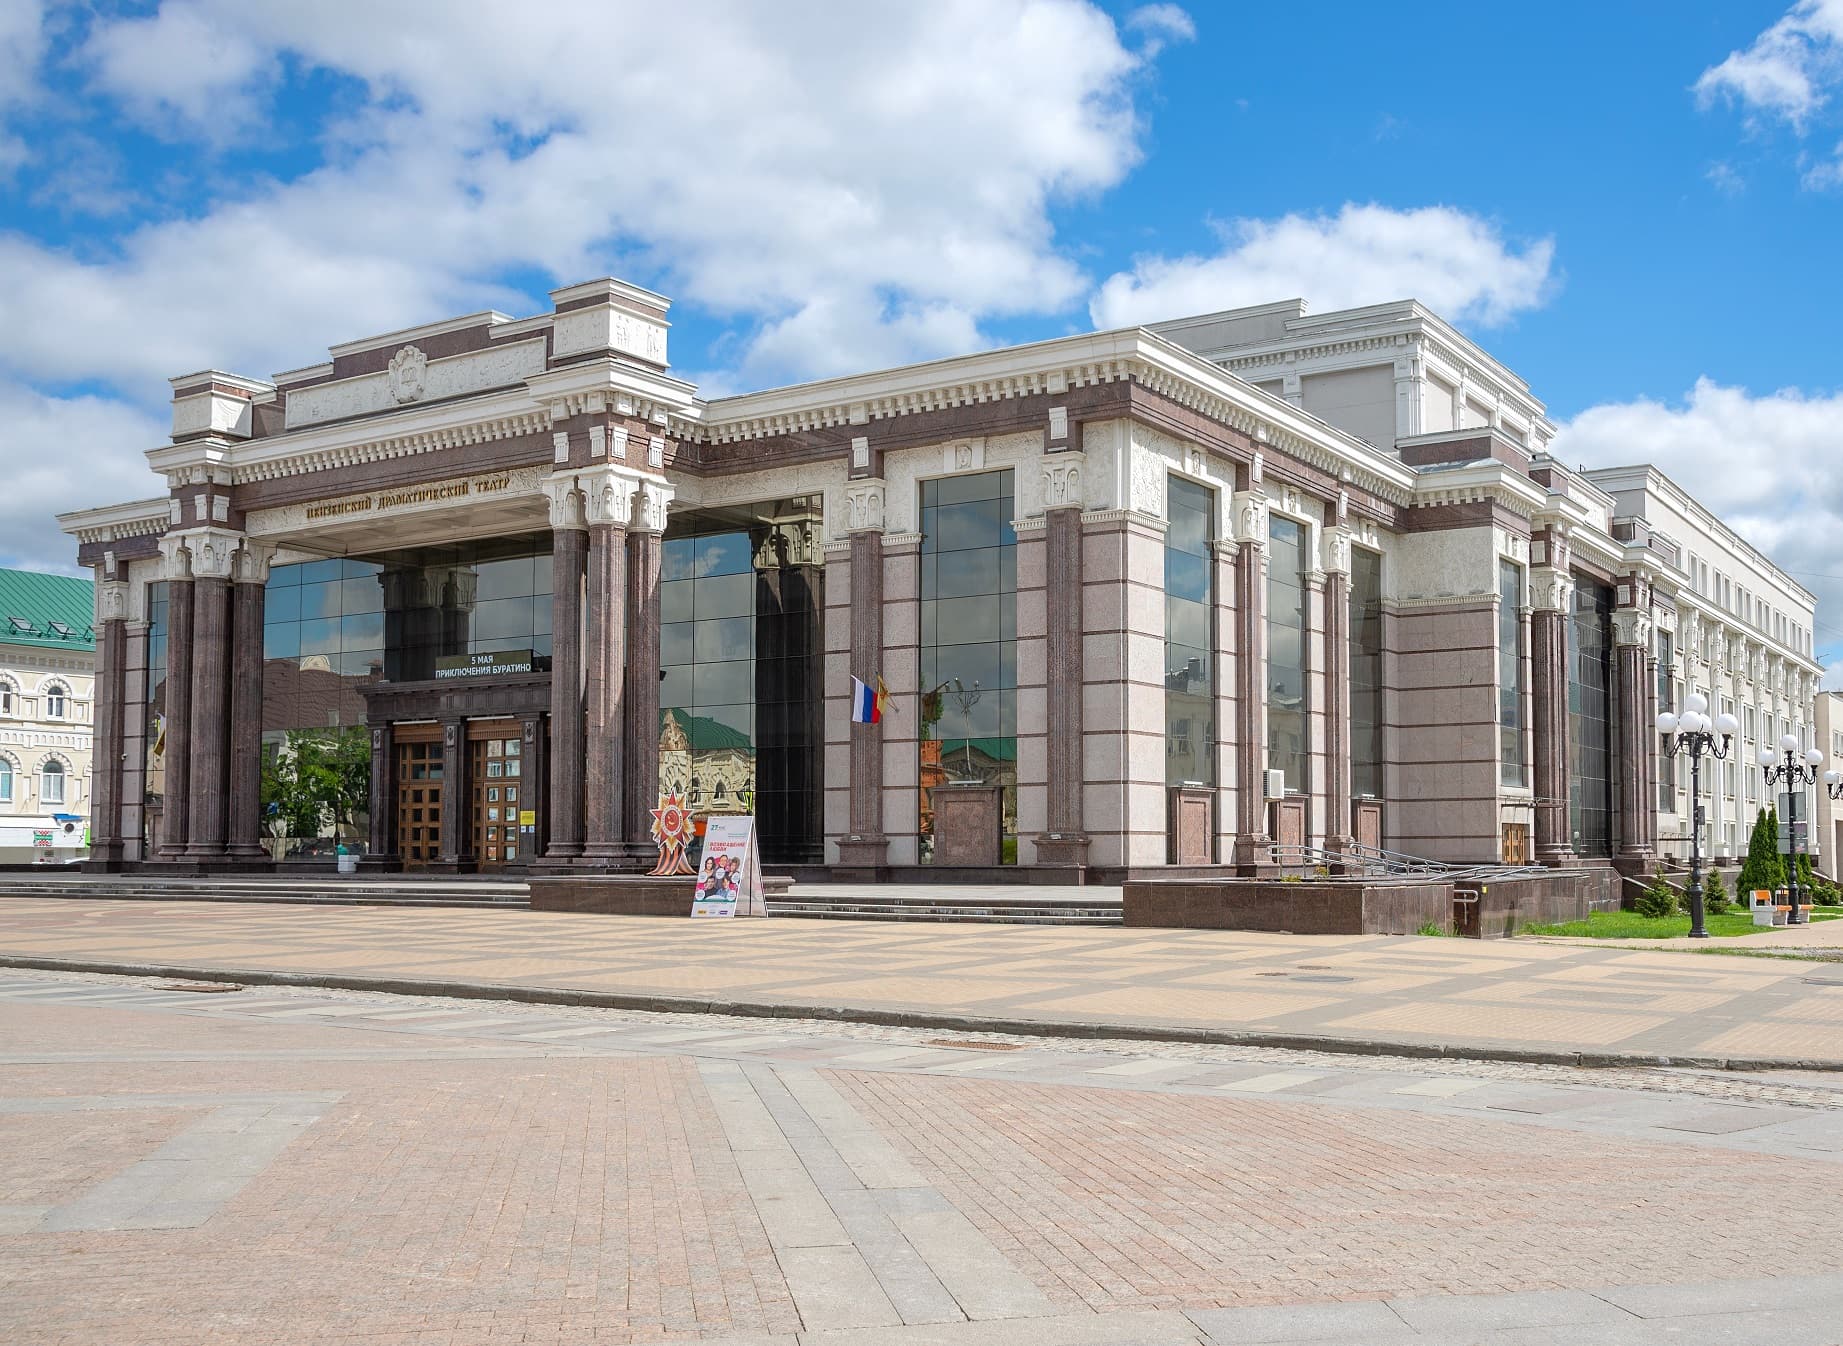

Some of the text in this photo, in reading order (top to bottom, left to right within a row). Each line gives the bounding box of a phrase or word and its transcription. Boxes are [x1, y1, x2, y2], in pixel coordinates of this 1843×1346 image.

[377, 482, 469, 510] ДРАМАТИЧЕСКИЙ
[475, 478, 510, 493] ТЕАТР
[471, 655, 494, 665] 5 МАЯ
[435, 663, 532, 679] ПРИКЛЮЧЕНИЯ БУРАТИНО
